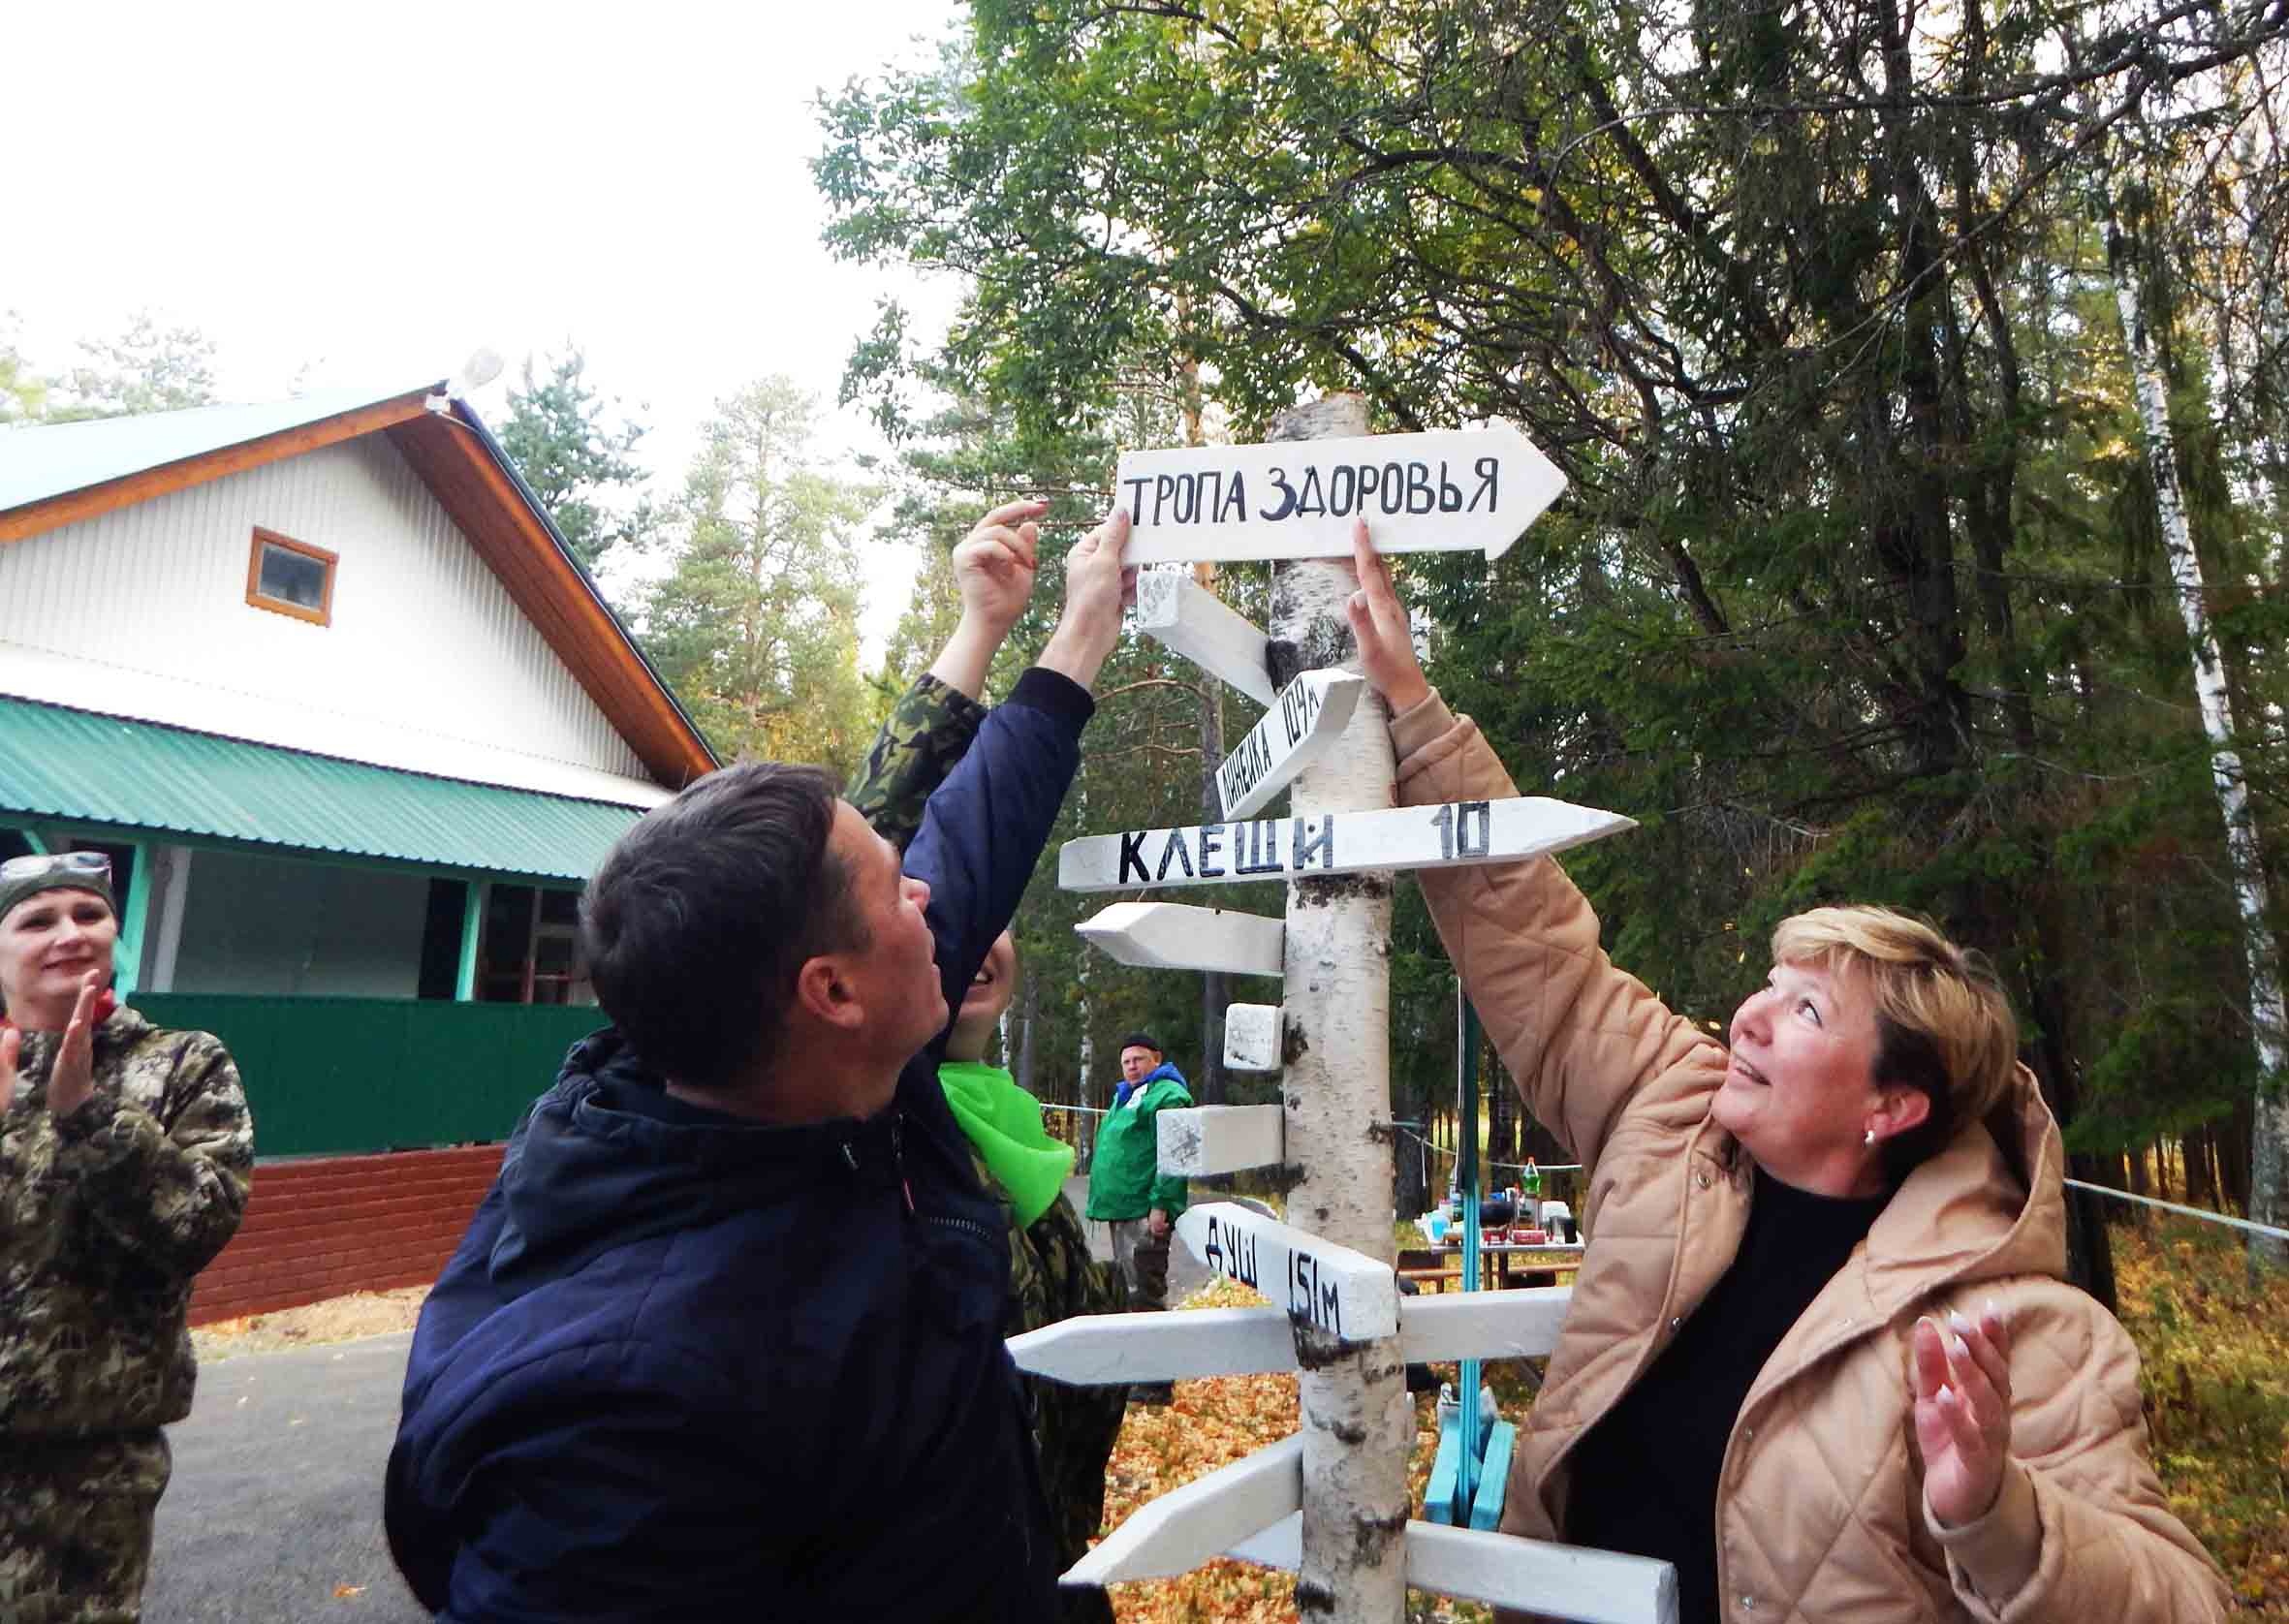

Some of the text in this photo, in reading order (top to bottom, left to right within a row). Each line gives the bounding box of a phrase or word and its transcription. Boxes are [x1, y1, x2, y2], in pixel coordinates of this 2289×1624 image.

[1123, 457, 1499, 525] ТРОПА ЗДОРОВЬЯ
[1430, 801, 1489, 860] 10
[1206, 1215, 1258, 1289] ДУШ
